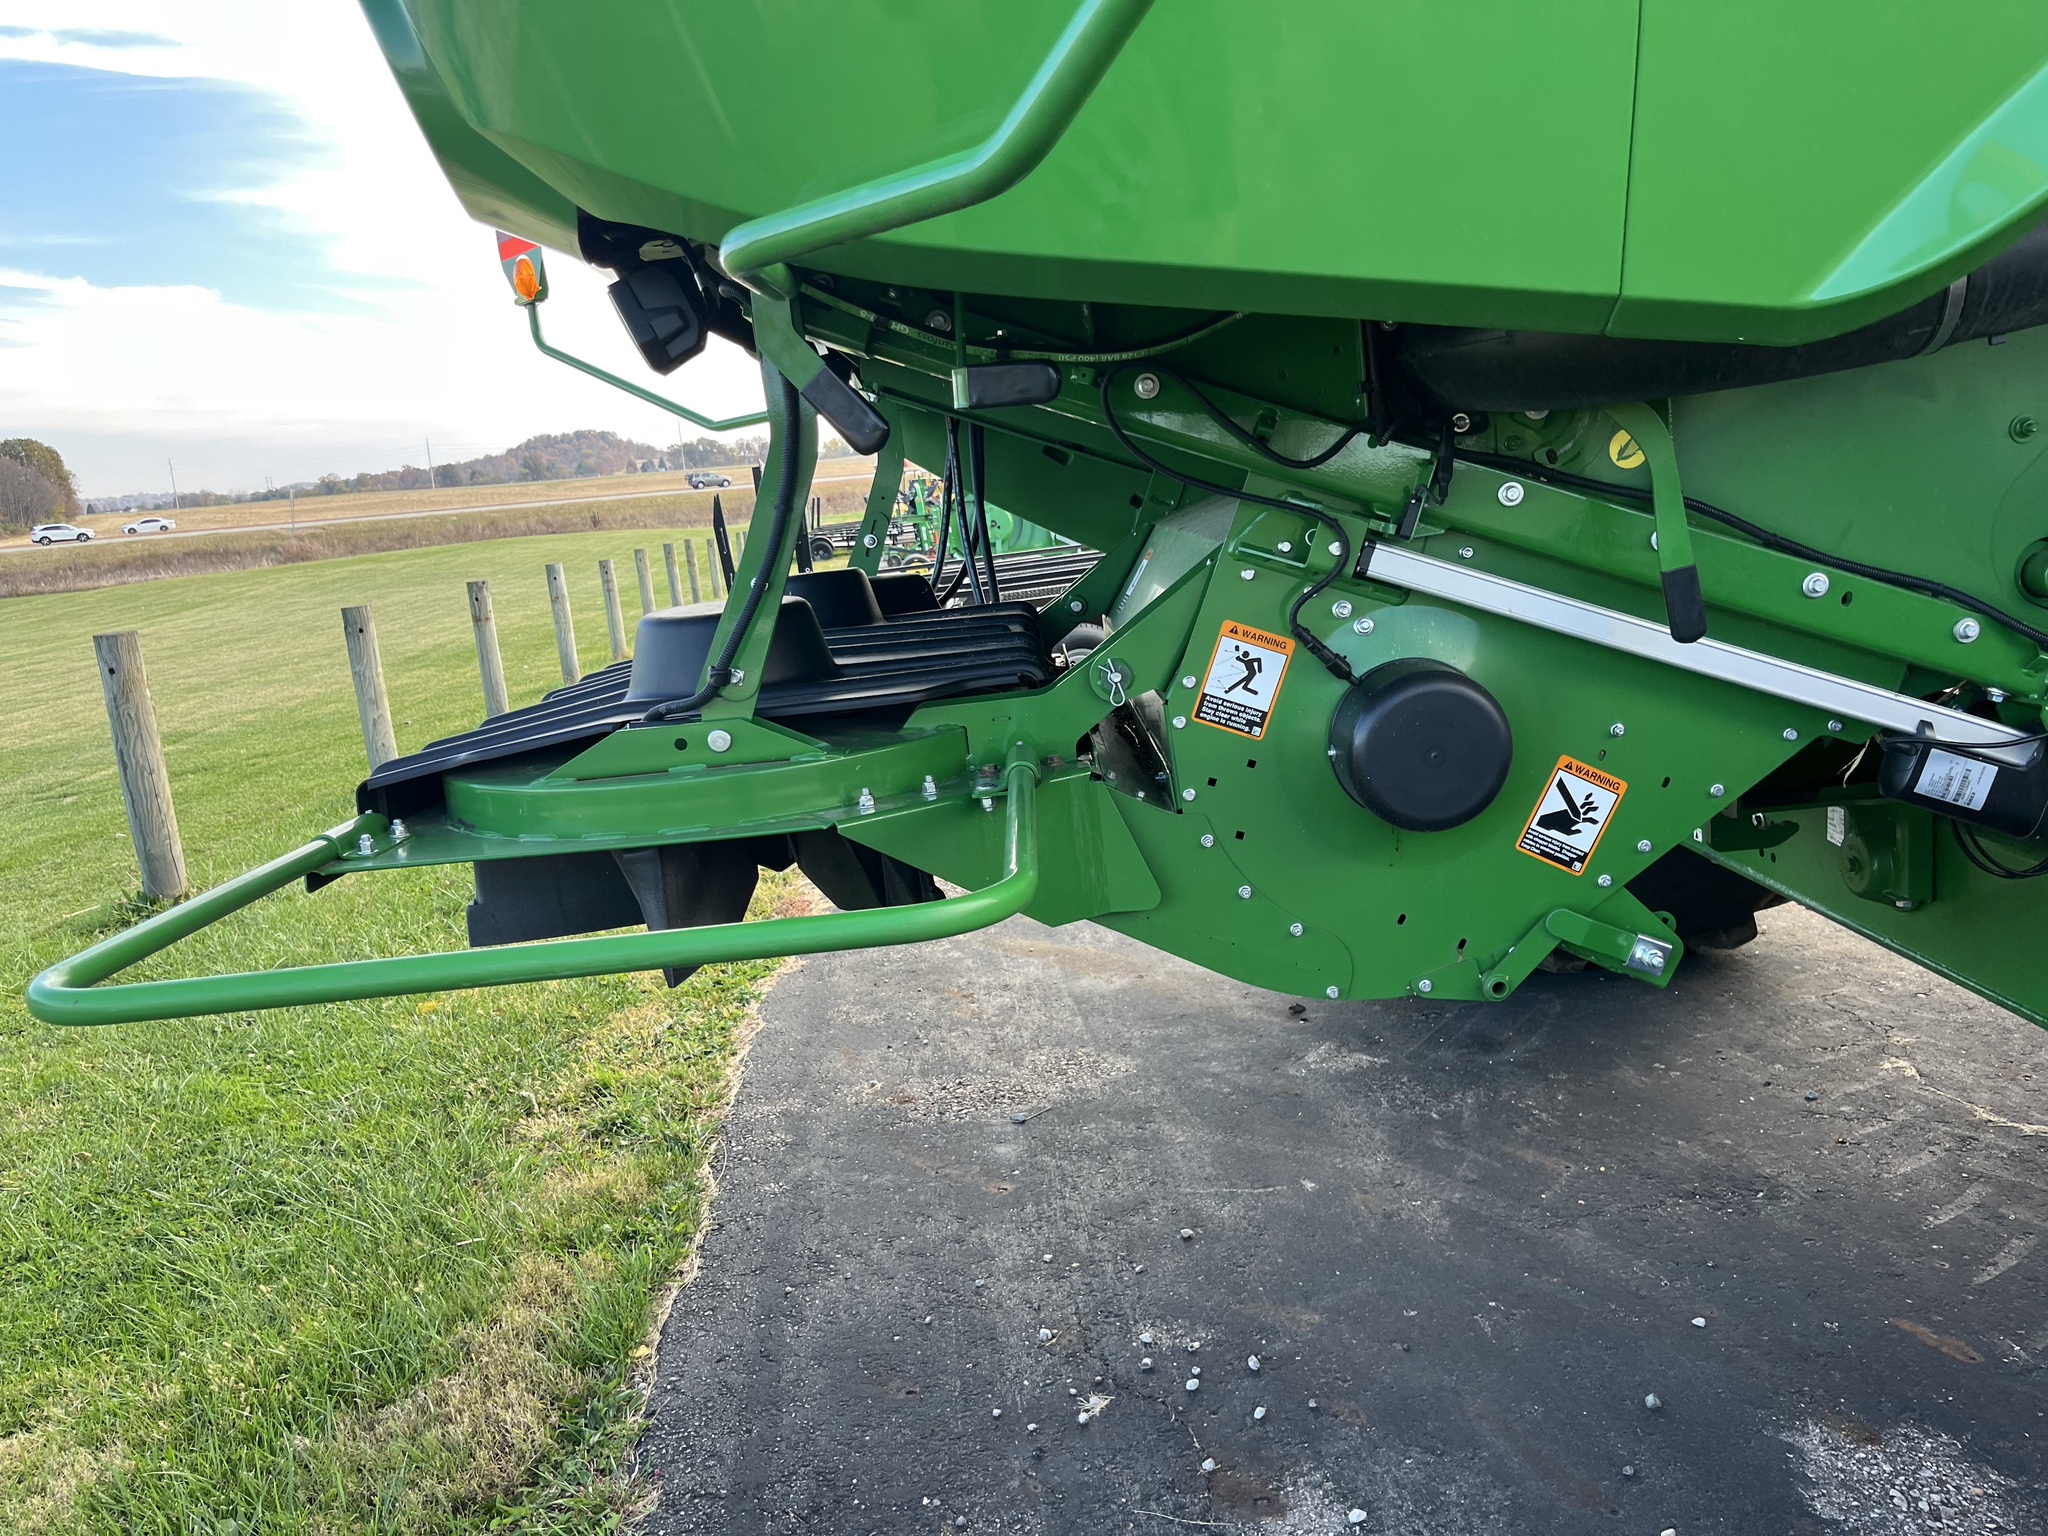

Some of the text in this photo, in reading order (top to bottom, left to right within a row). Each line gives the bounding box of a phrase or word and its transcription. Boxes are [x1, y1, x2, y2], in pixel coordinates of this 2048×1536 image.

[1242, 629, 1287, 650] WARNING
[1201, 706, 1247, 724] Stay clear while
[1203, 701, 1262, 723] from thrown objects.
[1205, 695, 1263, 718] Avoid serious injury
[1199, 712, 1220, 723] engine
[1226, 720, 1251, 732] running.
[1574, 764, 1621, 791] WARNING
